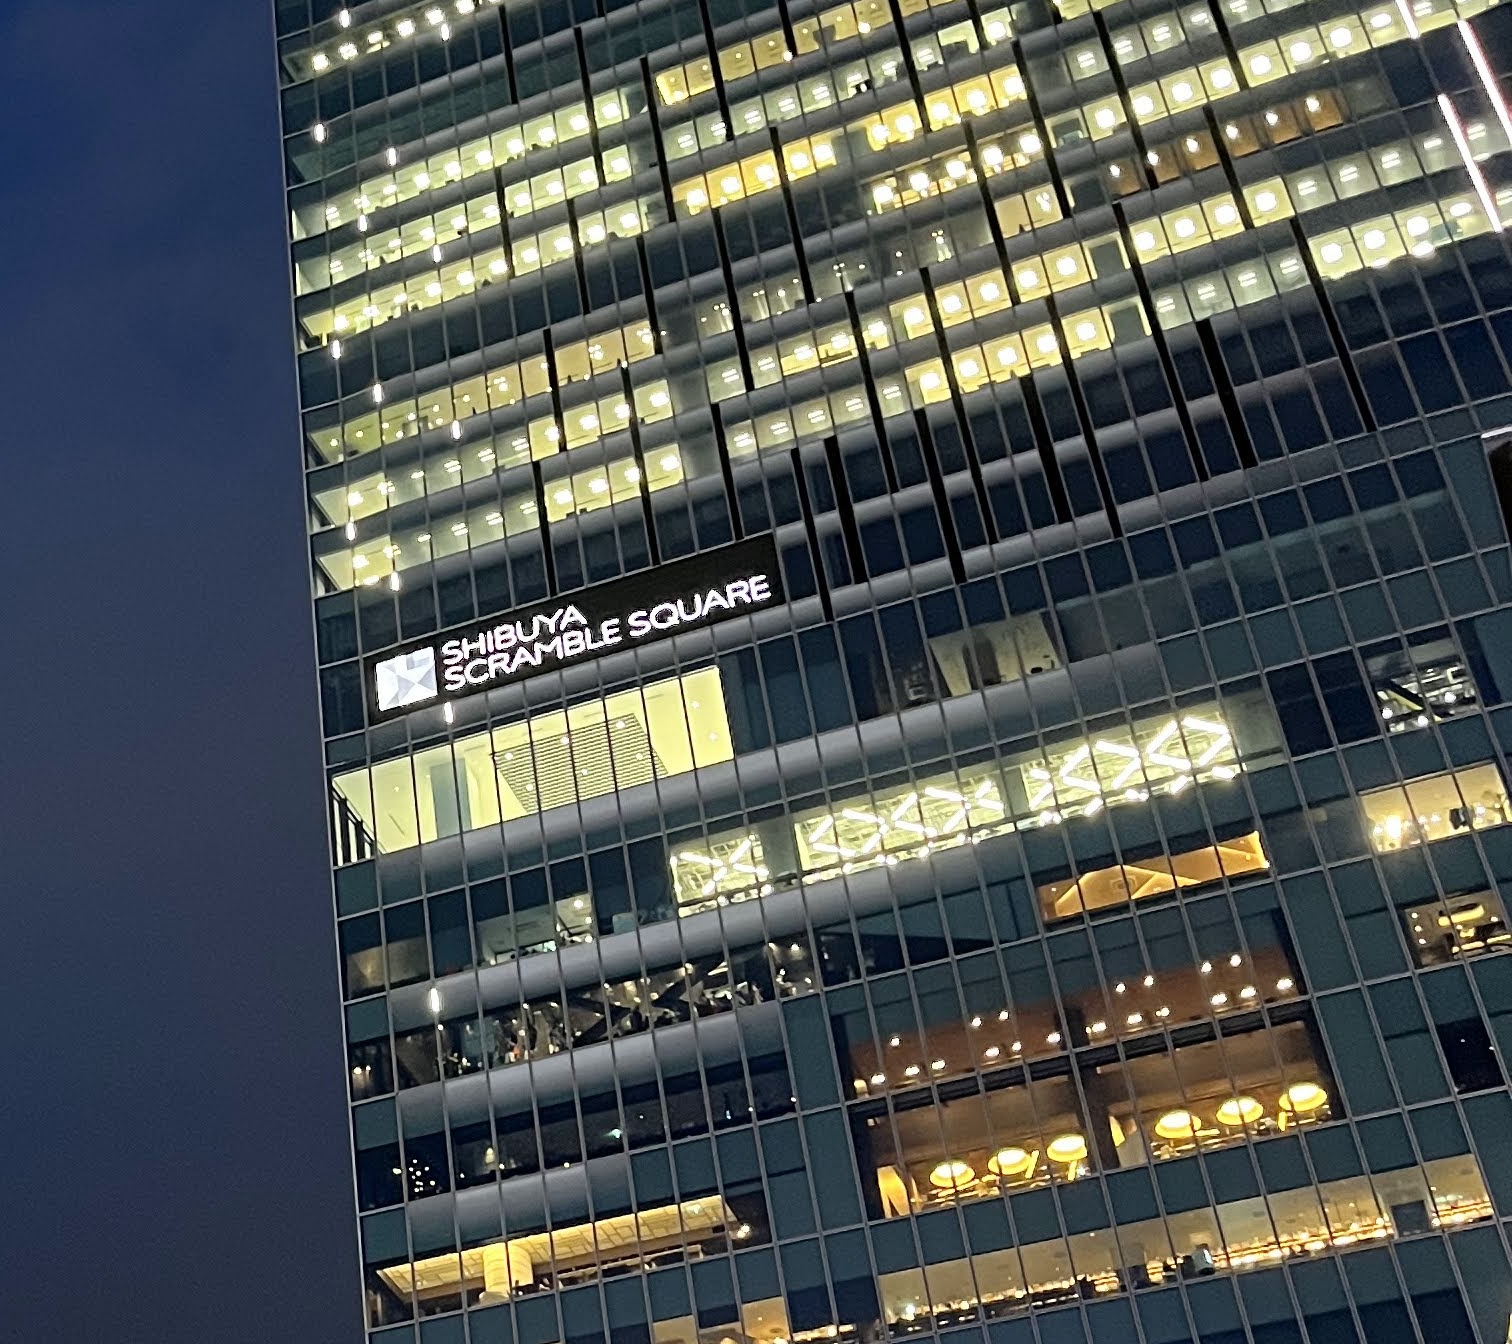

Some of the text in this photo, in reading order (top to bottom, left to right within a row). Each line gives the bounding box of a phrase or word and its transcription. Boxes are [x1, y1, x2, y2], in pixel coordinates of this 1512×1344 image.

[441, 605, 588, 664] SHIBUYA
[443, 573, 772, 692] SCRAMBLE SQUARE
